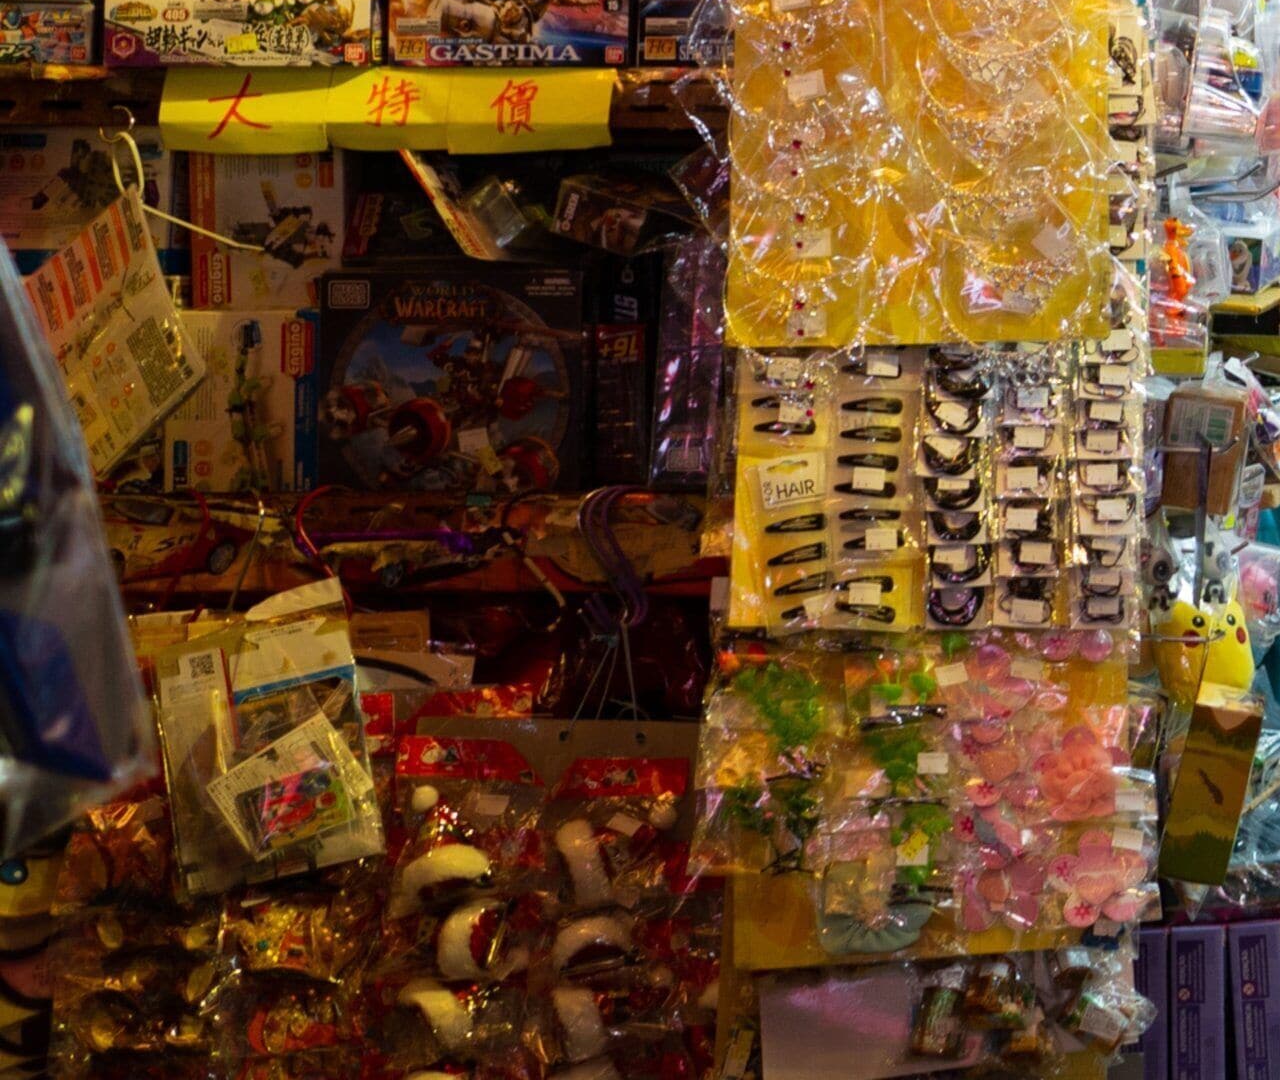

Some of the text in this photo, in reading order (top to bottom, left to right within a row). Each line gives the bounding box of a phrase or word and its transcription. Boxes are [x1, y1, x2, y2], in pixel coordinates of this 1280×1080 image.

[398, 38, 425, 56] HG
[429, 42, 582, 62] GASTIMA
[207, 73, 540, 139] 大特價
[393, 295, 488, 319] WARCRAFT
[776, 478, 816, 500] HAIR
